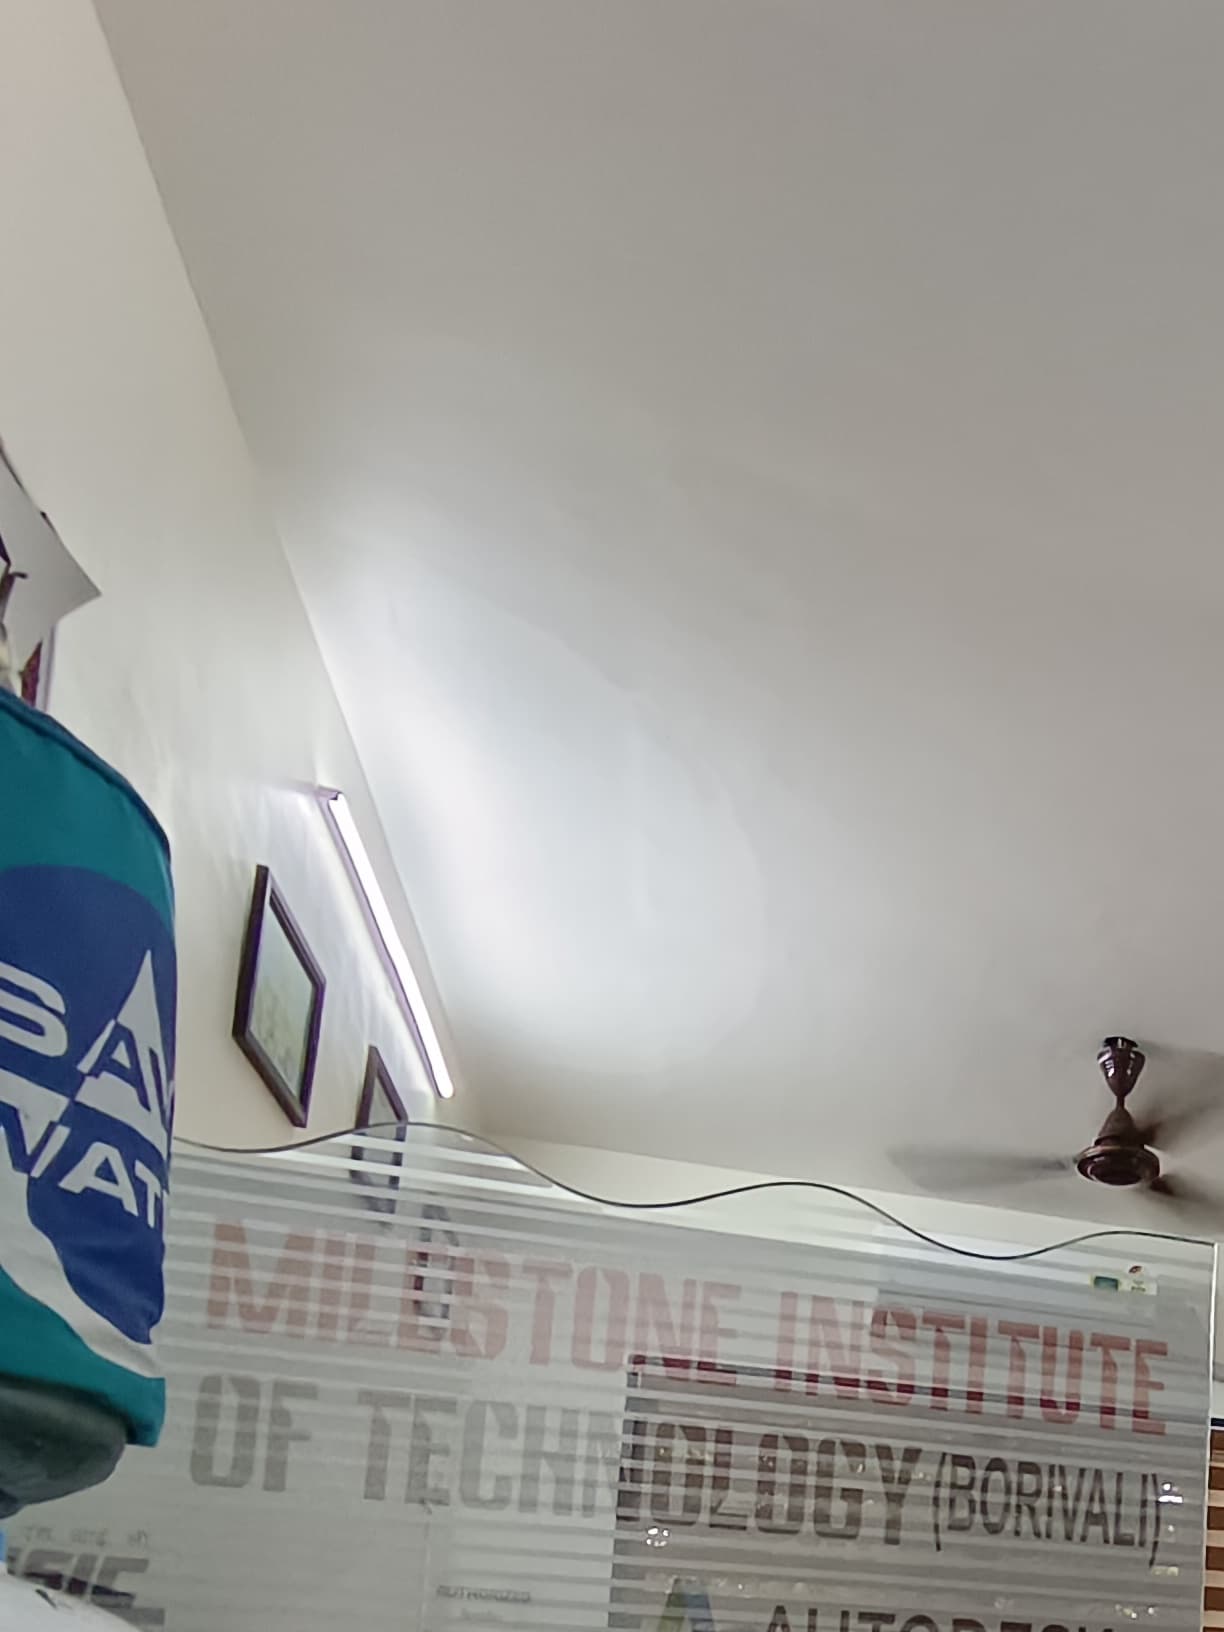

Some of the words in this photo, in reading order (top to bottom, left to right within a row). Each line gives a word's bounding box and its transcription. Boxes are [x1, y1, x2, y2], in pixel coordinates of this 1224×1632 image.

[206, 1217, 742, 1386] MILESTONE
[773, 1290, 1168, 1436] INSTITUTE
[189, 1373, 319, 1492] OF
[355, 1390, 922, 1546] TECHNOLOGY
[930, 1450, 1162, 1567] (BORIVALI)
